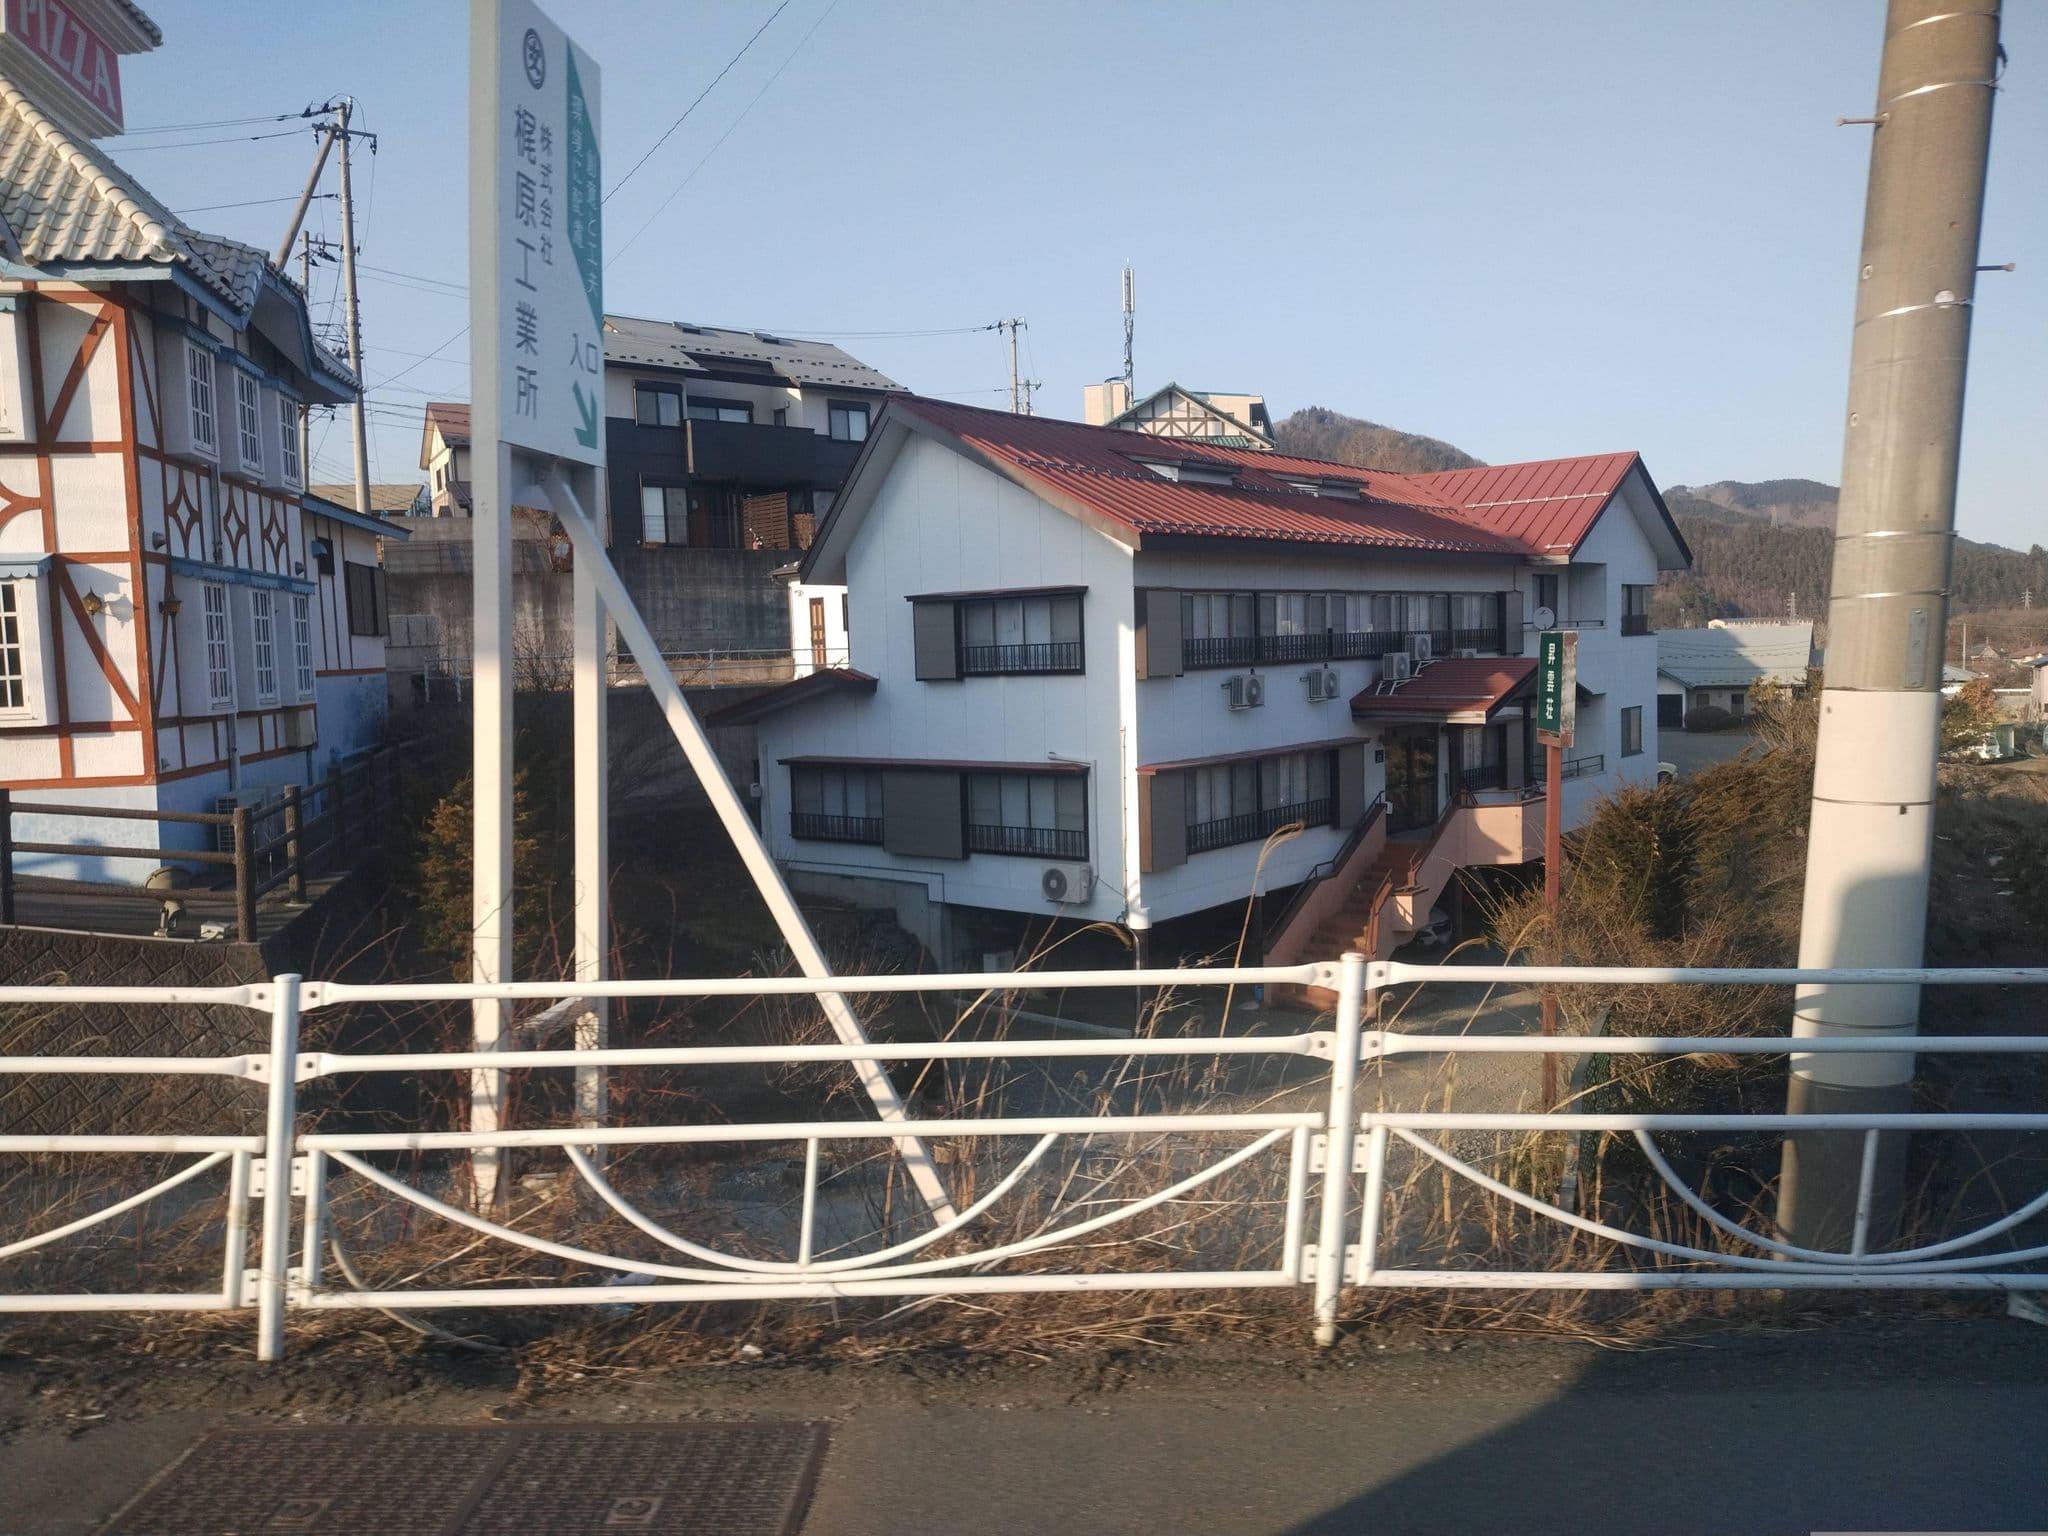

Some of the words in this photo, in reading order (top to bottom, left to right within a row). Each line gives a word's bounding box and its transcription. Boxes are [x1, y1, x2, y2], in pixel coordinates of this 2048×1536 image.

[540, 121, 554, 266] 株式会社
[570, 332, 598, 375] 入口
